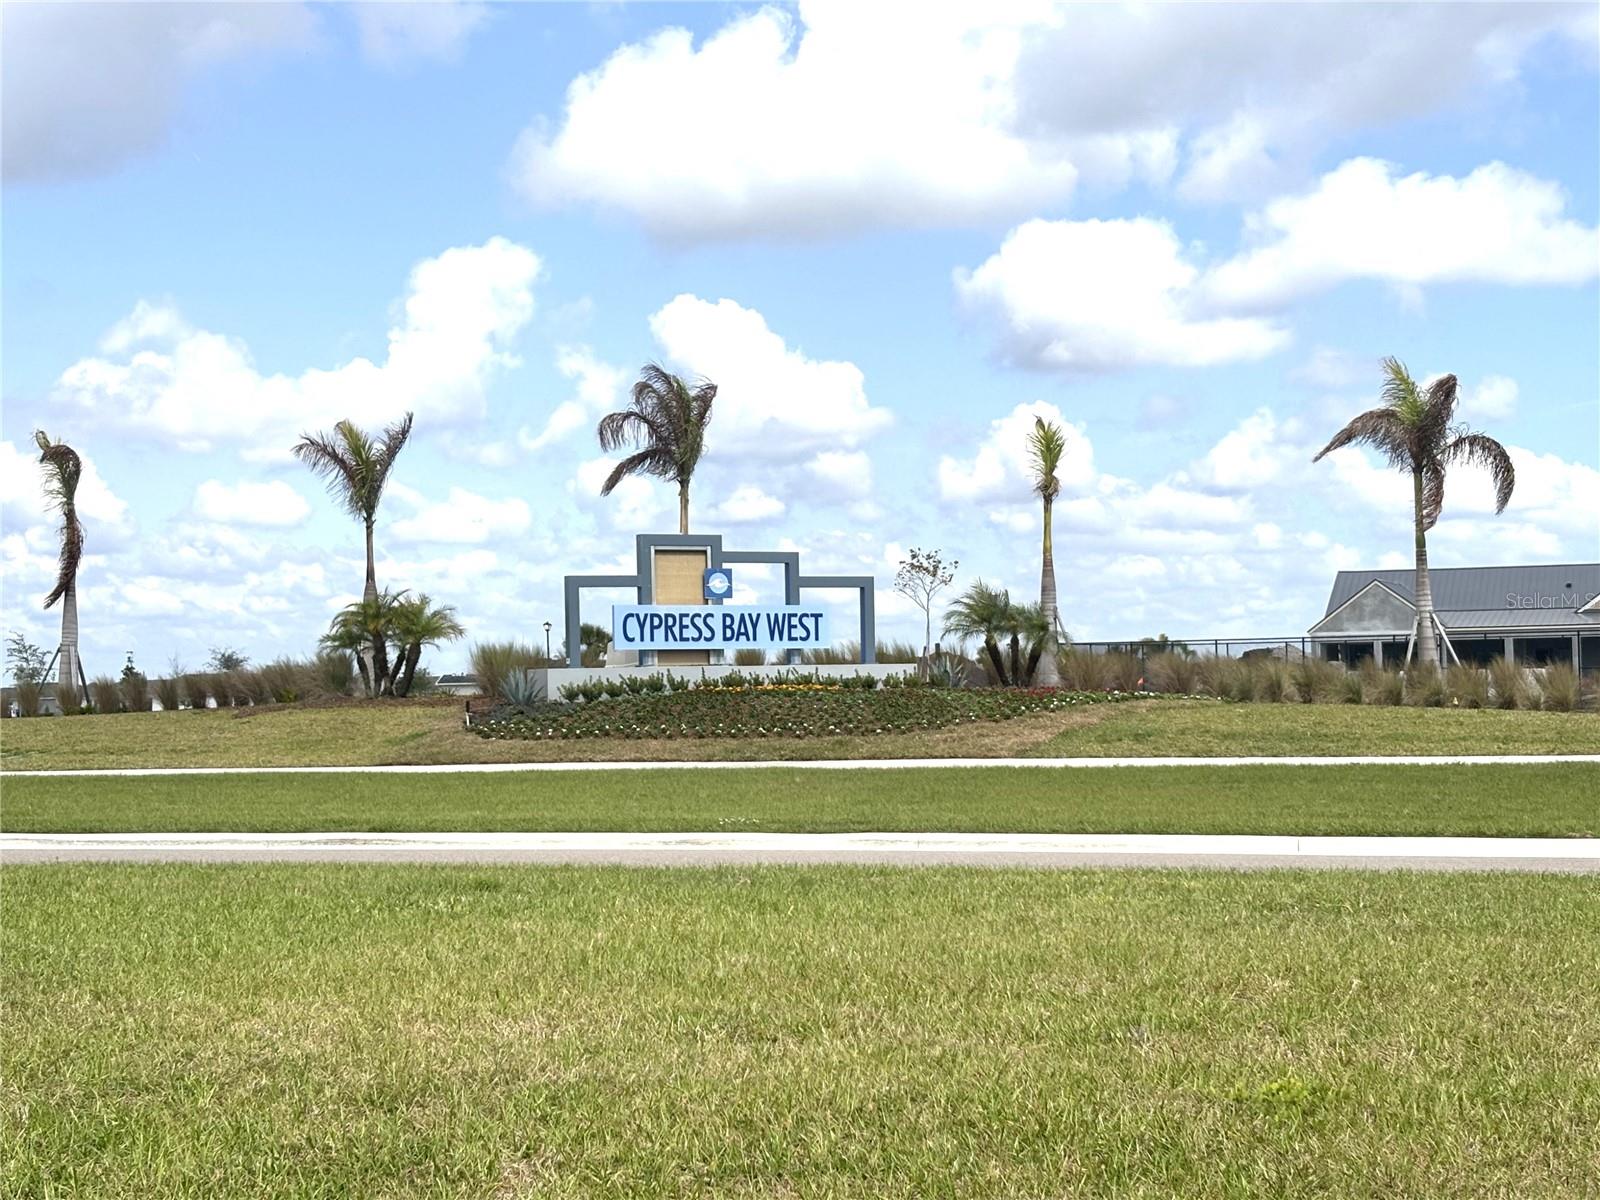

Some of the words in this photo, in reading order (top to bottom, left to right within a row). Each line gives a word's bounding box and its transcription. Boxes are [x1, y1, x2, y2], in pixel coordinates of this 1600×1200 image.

[622, 613, 716, 642] CYPRESS
[722, 613, 761, 642] BAY
[766, 613, 824, 642] WEST
